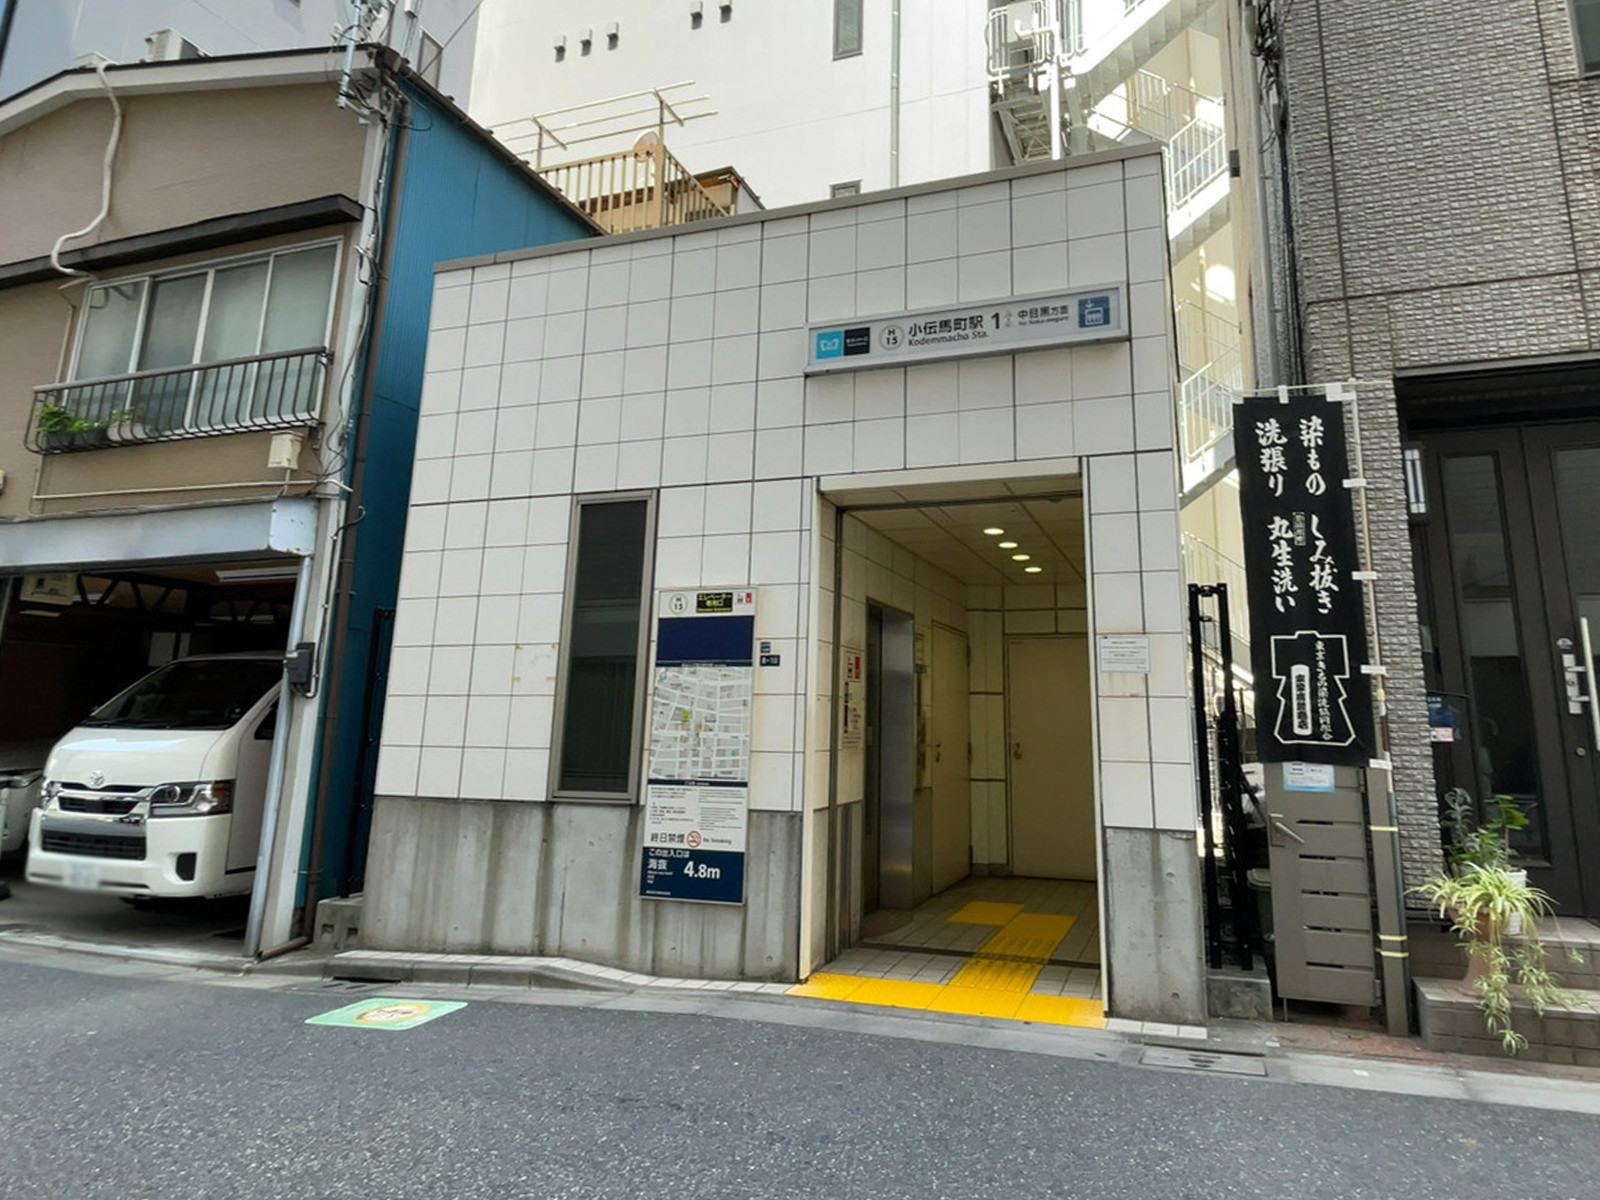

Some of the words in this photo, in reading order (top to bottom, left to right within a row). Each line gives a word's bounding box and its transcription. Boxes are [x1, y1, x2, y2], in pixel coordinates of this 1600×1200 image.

[908, 315, 984, 337] 小伝馬町駅
[991, 312, 1000, 330] 1
[886, 336, 898, 345] 15
[908, 330, 969, 347] Kodemmacho
[971, 329, 989, 340] Sta.
[1254, 417, 1289, 498] 洗張り
[1298, 415, 1327, 496] 染もの
[1267, 515, 1299, 613] 丸生洗い
[1308, 514, 1340, 615] しみ抜き
[650, 832, 685, 844] 終日禁煙
[648, 848, 690, 858] この出入口は
[683, 860, 721, 879] 4.8m
